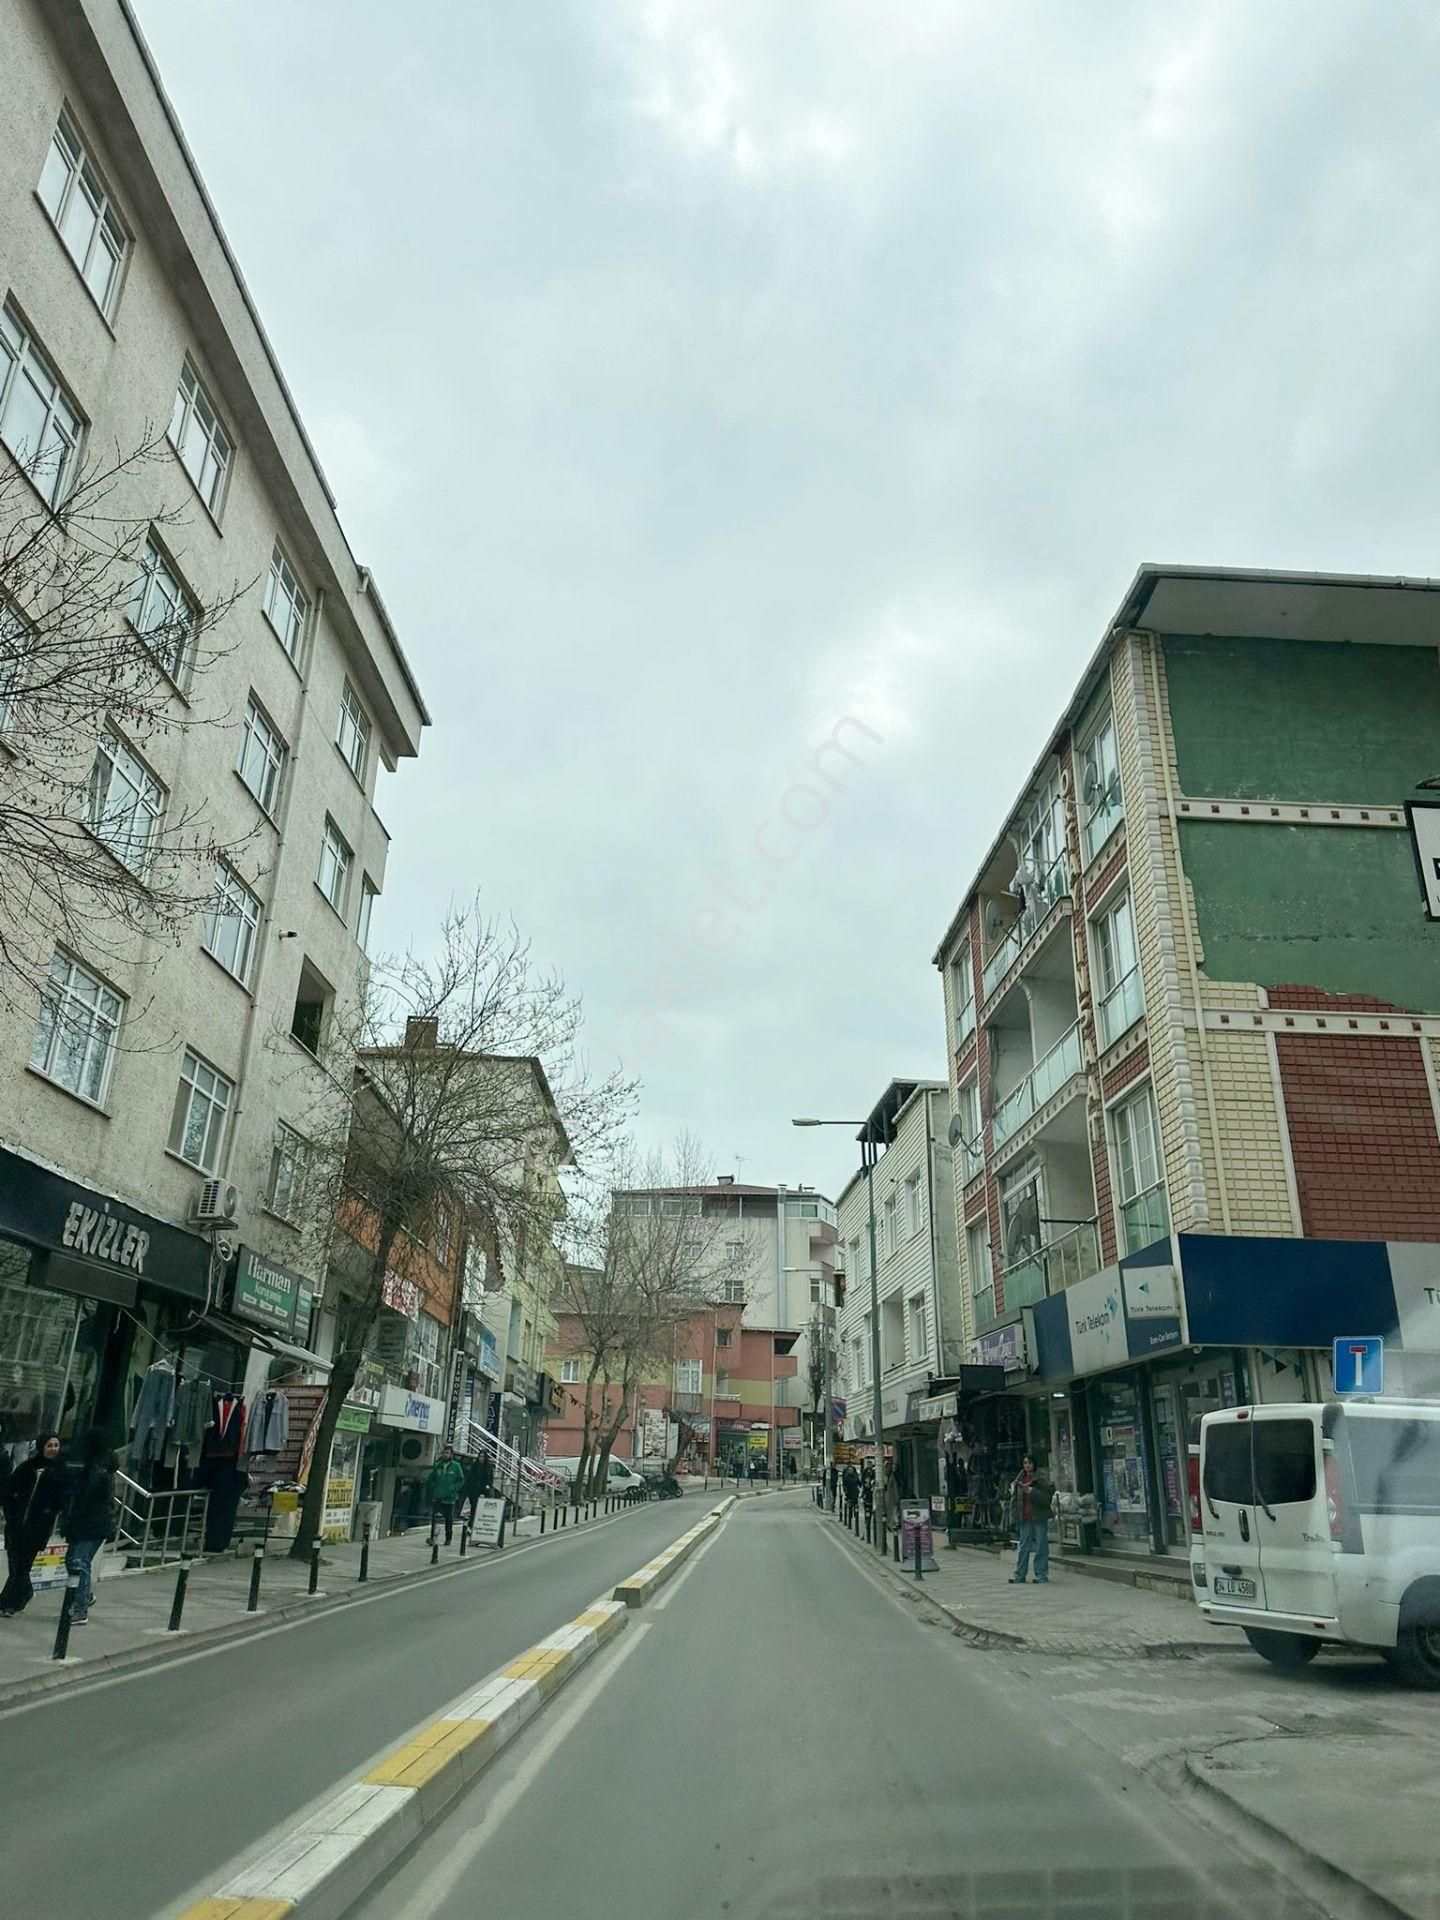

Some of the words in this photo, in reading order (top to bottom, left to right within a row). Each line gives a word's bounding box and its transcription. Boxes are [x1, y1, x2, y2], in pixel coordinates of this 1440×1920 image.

[62, 1202, 150, 1274] EKİZLER
[247, 1254, 291, 1294] Harman
[1075, 1319, 1087, 1335] Türk
[1087, 1312, 1110, 1331] Telekom
